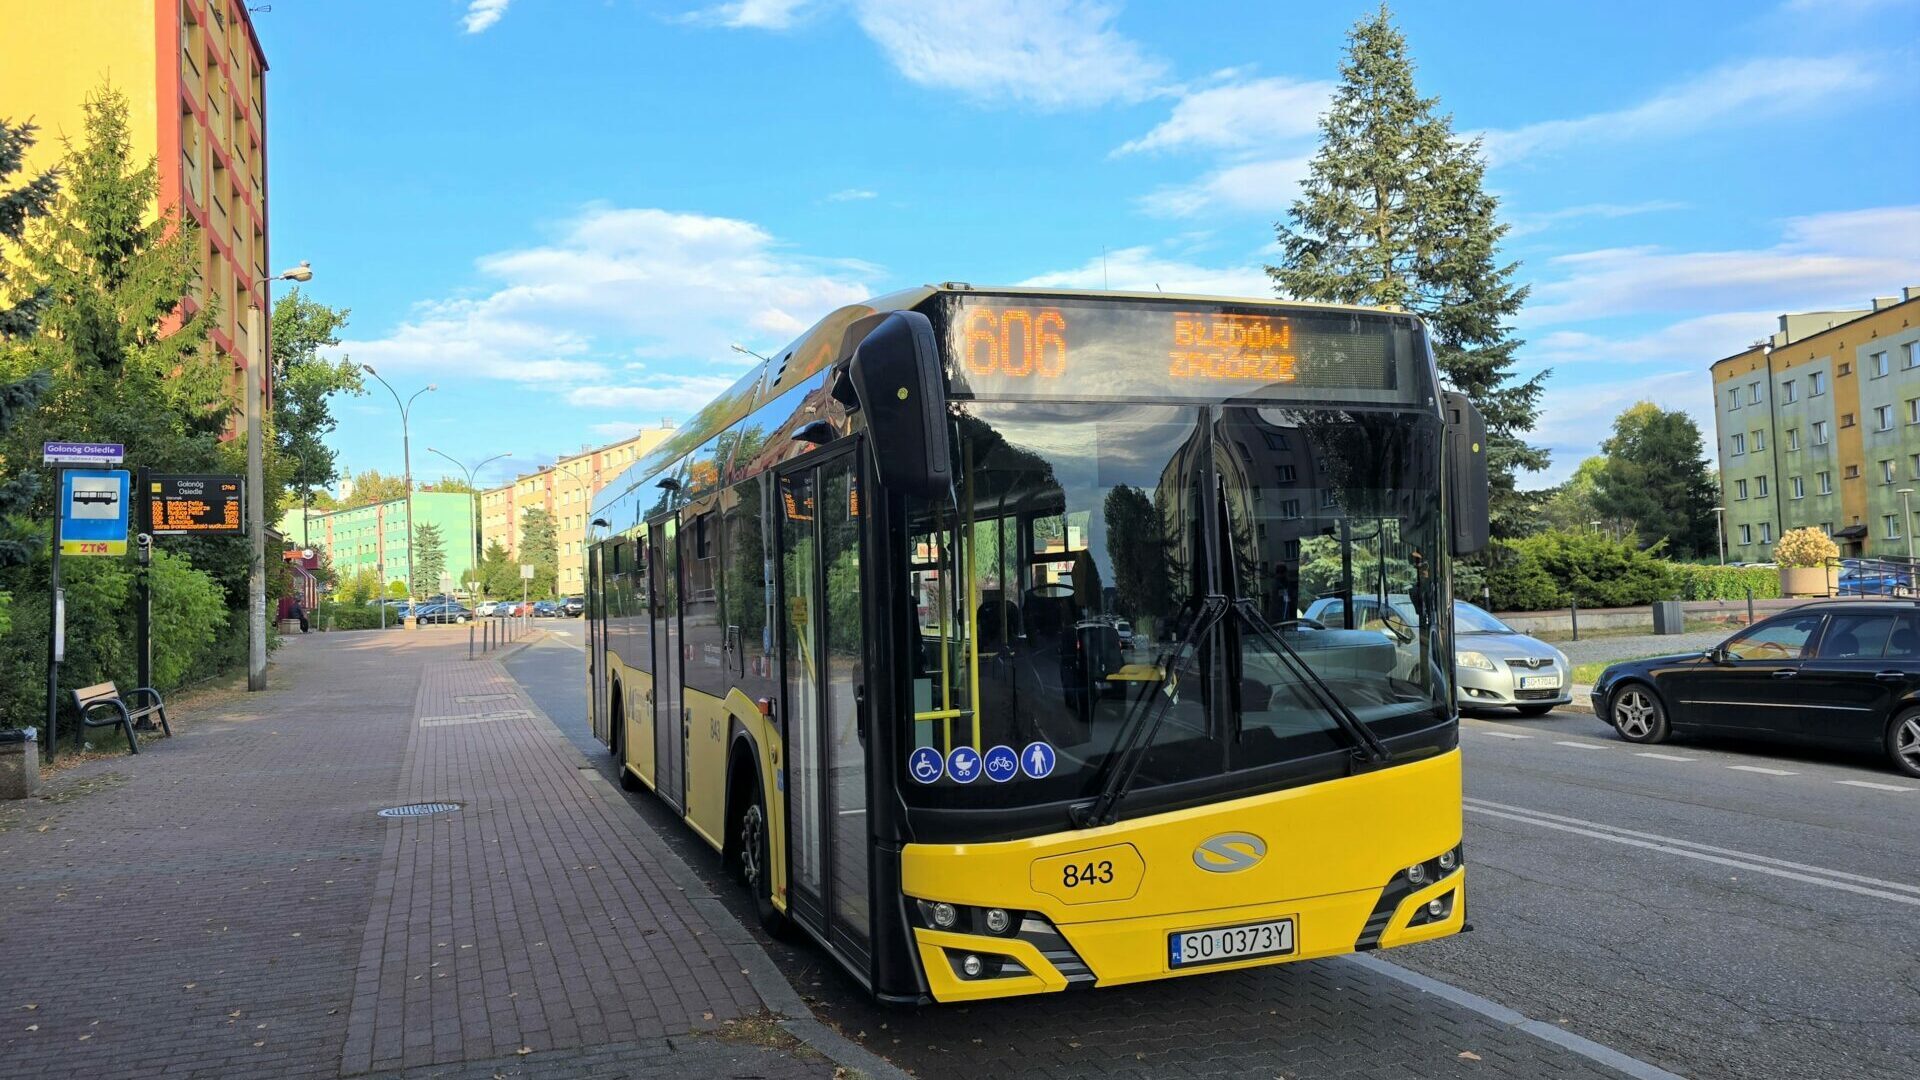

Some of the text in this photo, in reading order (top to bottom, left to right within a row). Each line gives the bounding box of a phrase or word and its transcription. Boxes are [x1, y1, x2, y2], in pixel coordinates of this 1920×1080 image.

[965, 307, 1066, 378] 606
[47, 445, 116, 454] Golonóg Osiedle
[177, 480, 204, 489] Golonóg
[80, 543, 108, 553] ZTM
[710, 717, 721, 743] 843
[1063, 860, 1114, 888] 843
[1172, 924, 1286, 960] PL SO 0373Y
